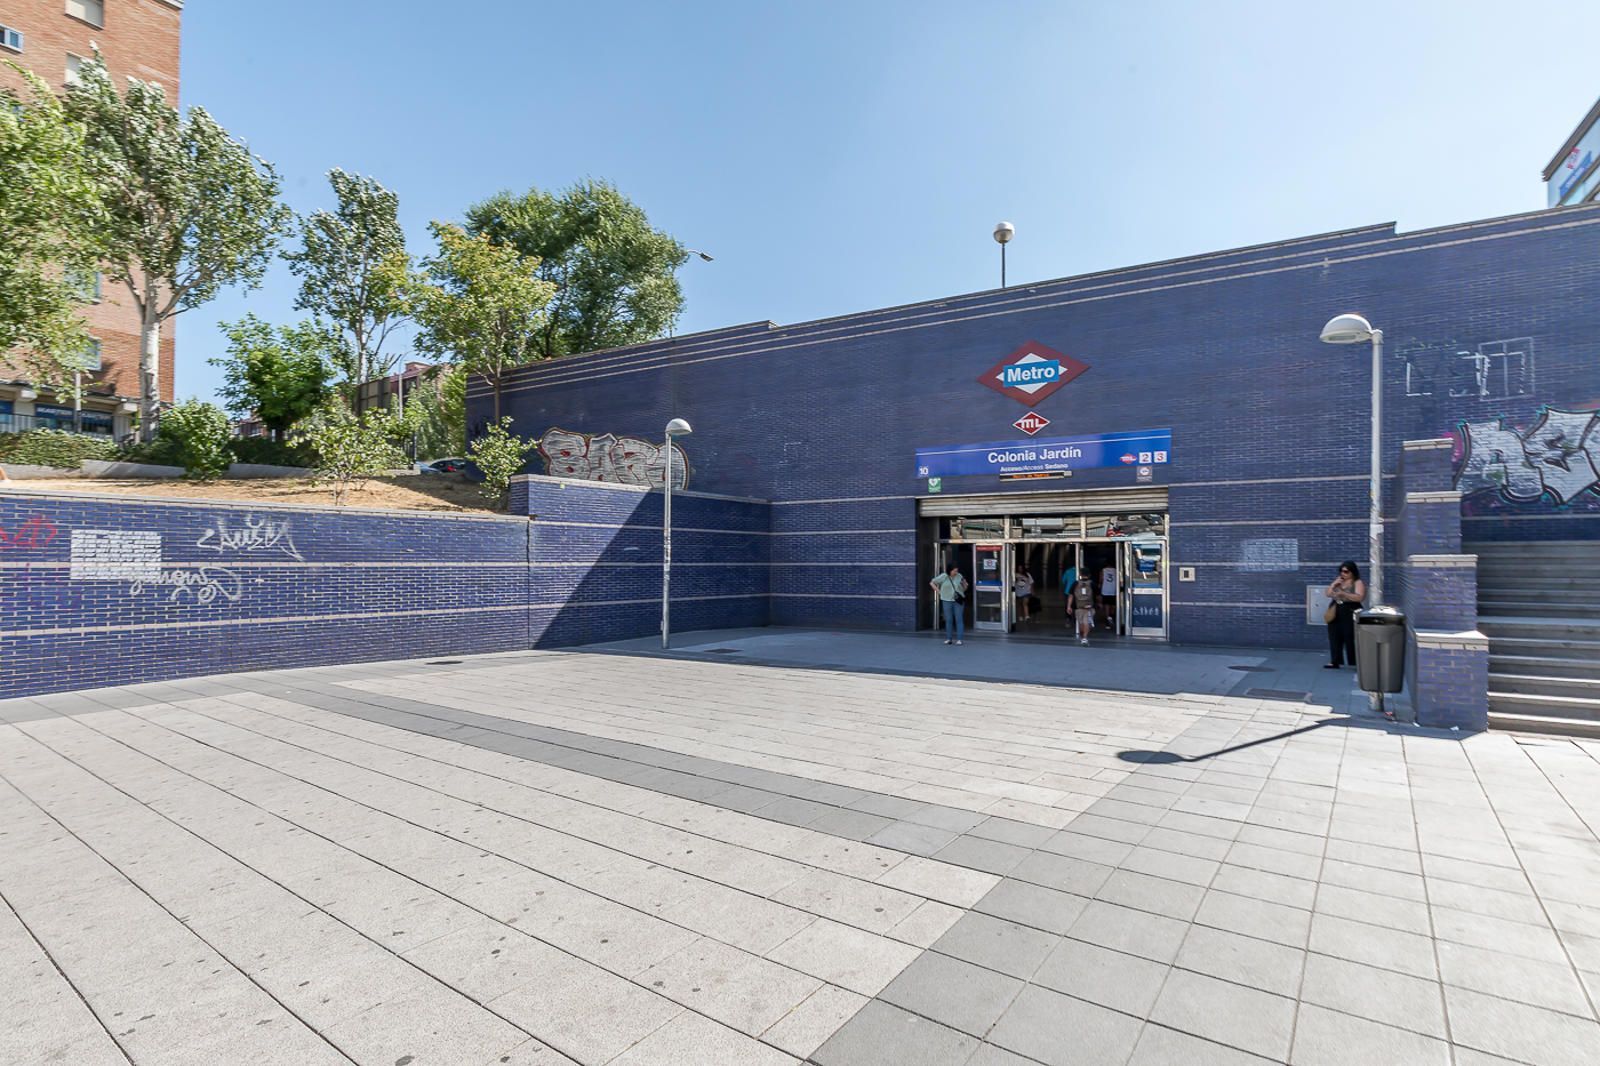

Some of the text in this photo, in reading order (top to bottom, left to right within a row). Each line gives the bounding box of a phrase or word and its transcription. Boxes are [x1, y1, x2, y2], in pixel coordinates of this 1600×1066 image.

[1007, 366, 1056, 384] Metro
[988, 447, 1081, 463] Colonia Jardín
[1142, 453, 1149, 462] 2
[1157, 452, 1164, 461] 3
[919, 465, 929, 475] 10
